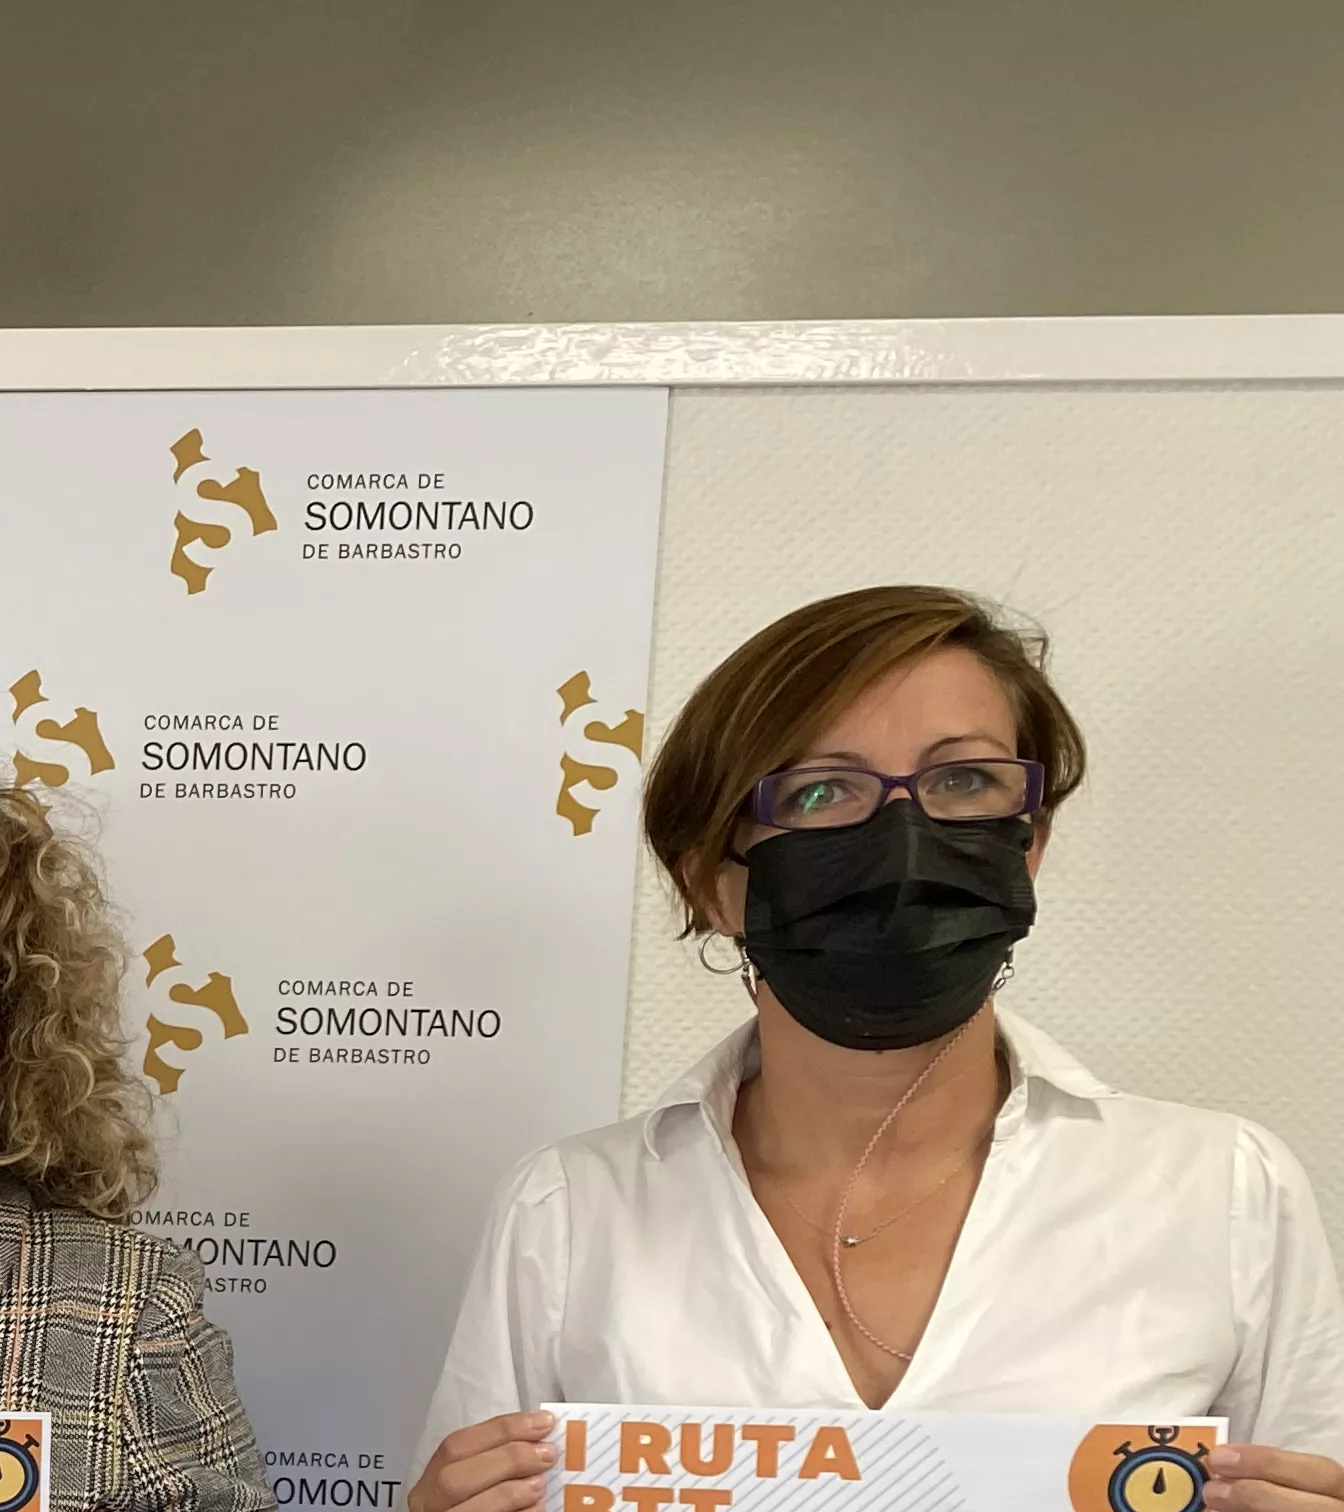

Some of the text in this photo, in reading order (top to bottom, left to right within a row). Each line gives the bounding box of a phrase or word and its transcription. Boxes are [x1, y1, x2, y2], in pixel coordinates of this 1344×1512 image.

[308, 474, 445, 489] COMARCA DE
[305, 501, 533, 530] SOMONTANO
[303, 543, 461, 559] DE BARBASTRO
[145, 715, 279, 730] COMARCA DE
[142, 742, 366, 771] SOMONTANO
[140, 783, 296, 799] DE BARBASTRO
[565, 1421, 859, 1480] I RUTA
